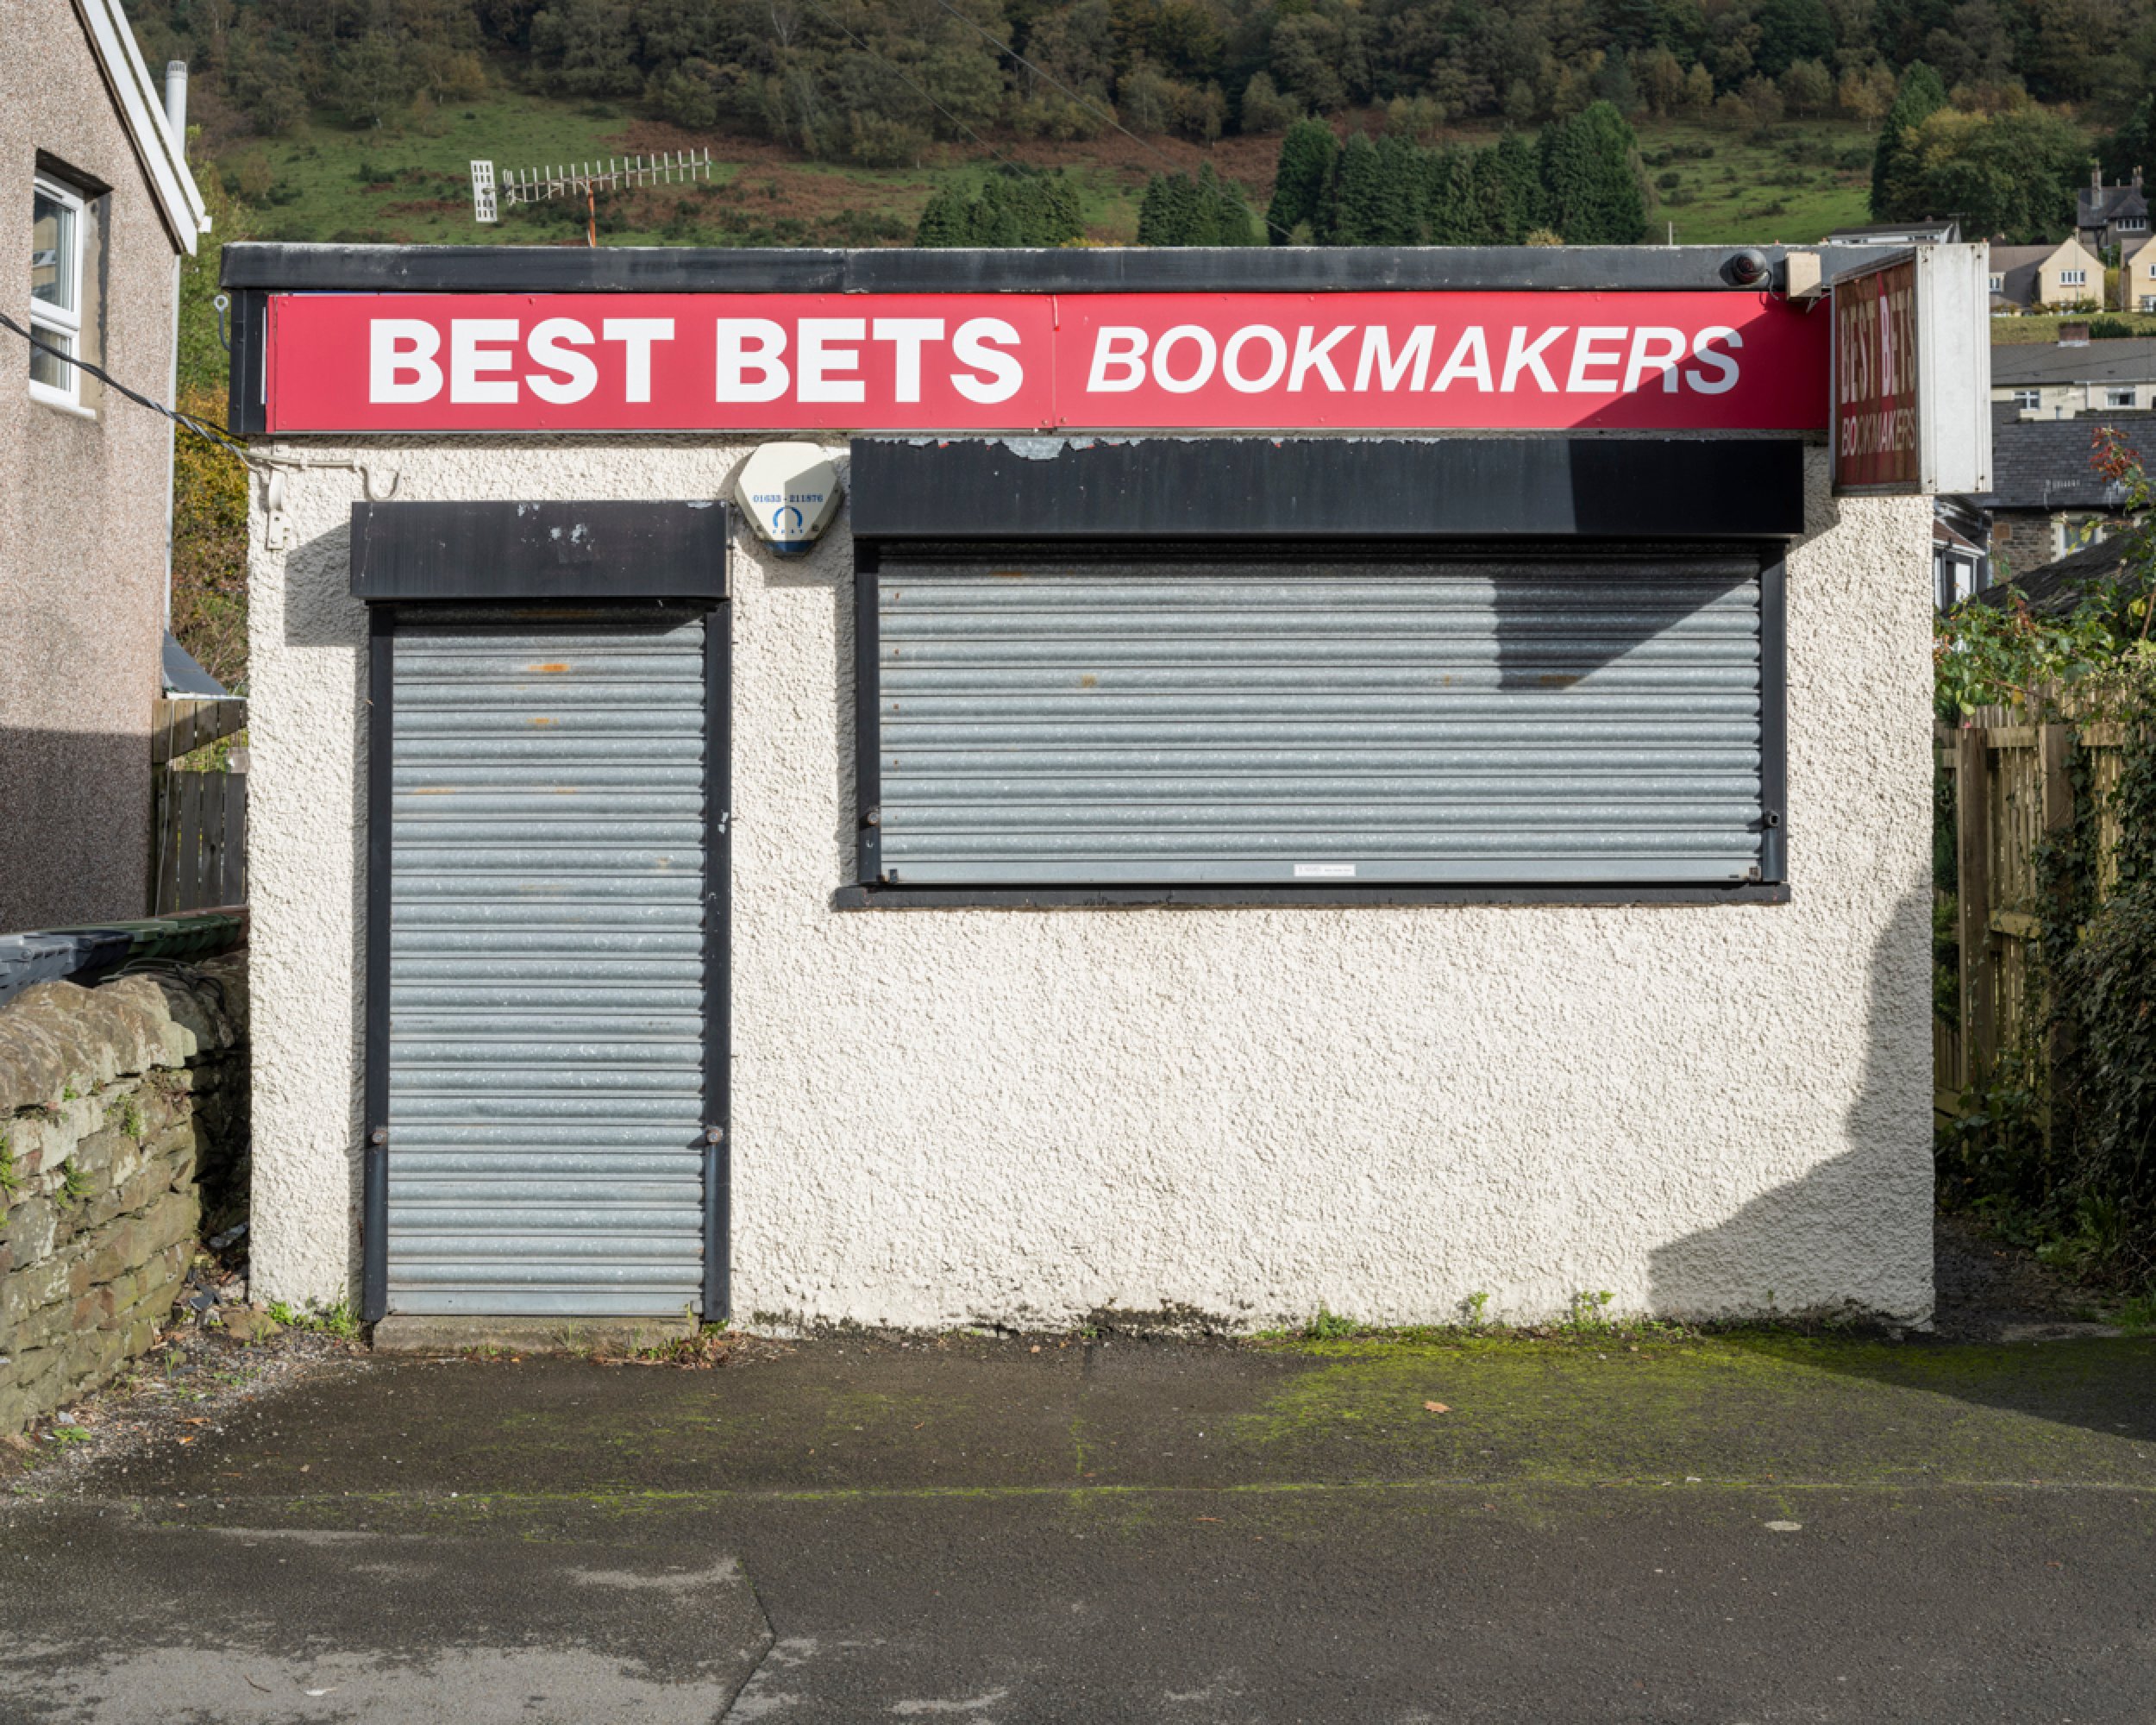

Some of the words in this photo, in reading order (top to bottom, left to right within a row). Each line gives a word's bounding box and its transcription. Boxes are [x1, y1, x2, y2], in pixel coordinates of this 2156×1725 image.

[369, 317, 675, 405] BEST
[716, 317, 1025, 405] BETS
[1085, 323, 1743, 394] BOOKMAKERS
[1841, 299, 1876, 405] BEST
[1879, 286, 1915, 397] BETS
[1841, 407, 1915, 457] BOOKMAKERS
